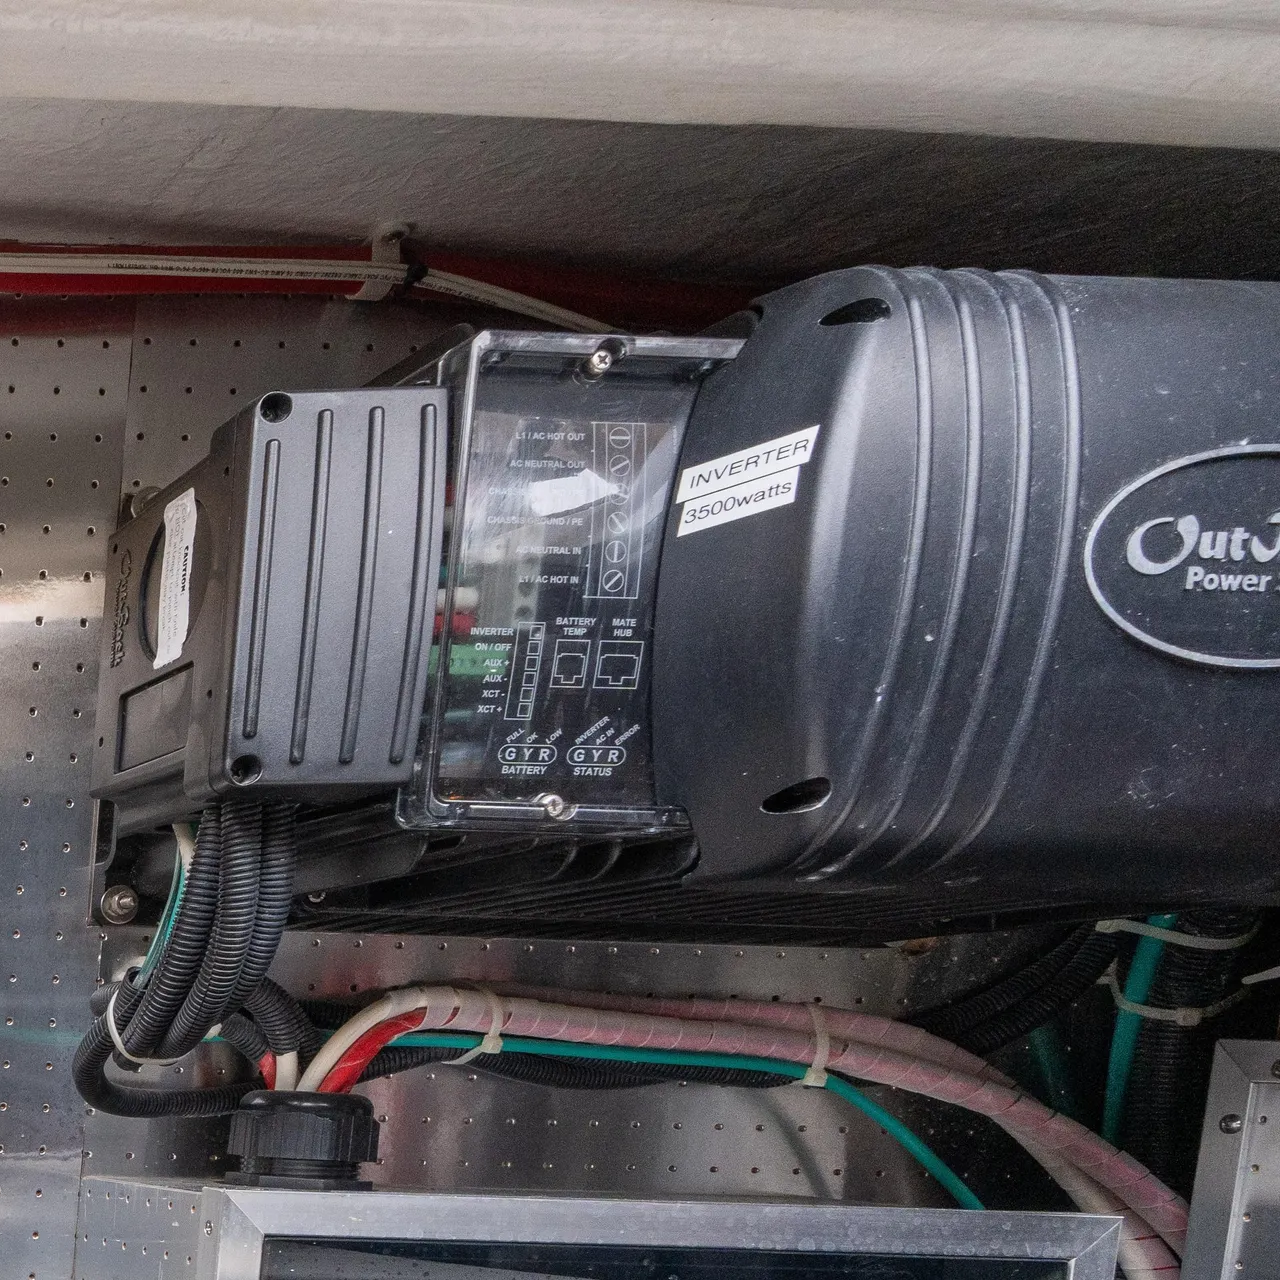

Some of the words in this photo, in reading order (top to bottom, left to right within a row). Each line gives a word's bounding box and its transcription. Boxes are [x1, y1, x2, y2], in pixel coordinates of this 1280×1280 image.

[567, 433, 585, 441] OUT
[690, 439, 809, 489] INVERTER
[684, 482, 792, 524] 3500watts
[487, 516, 525, 524] CHASSIS
[572, 518, 583, 526] PE
[570, 576, 579, 584] IN
[1185, 566, 1272, 592] Power
[556, 617, 596, 626] BATTERY
[612, 619, 637, 627] MATE
[471, 628, 514, 636] INVERTER
[563, 628, 587, 636] TEMP
[613, 628, 632, 636] HUB
[483, 675, 502, 683] AUX
[477, 705, 495, 713] XCT
[575, 715, 610, 745] INVERTER
[614, 724, 640, 746] ERROR
[505, 728, 525, 744] FULL
[526, 733, 538, 744] OK
[545, 729, 563, 745] LOW
[595, 734, 606, 745] AC
[605, 728, 615, 737] IN
[505, 748, 516, 760] G
[523, 748, 533, 760] Y
[539, 749, 550, 760] R
[574, 750, 585, 761] G
[592, 750, 603, 761] Y
[608, 750, 619, 762] R
[502, 766, 547, 775] BATTERY
[574, 767, 612, 776] STATUS
